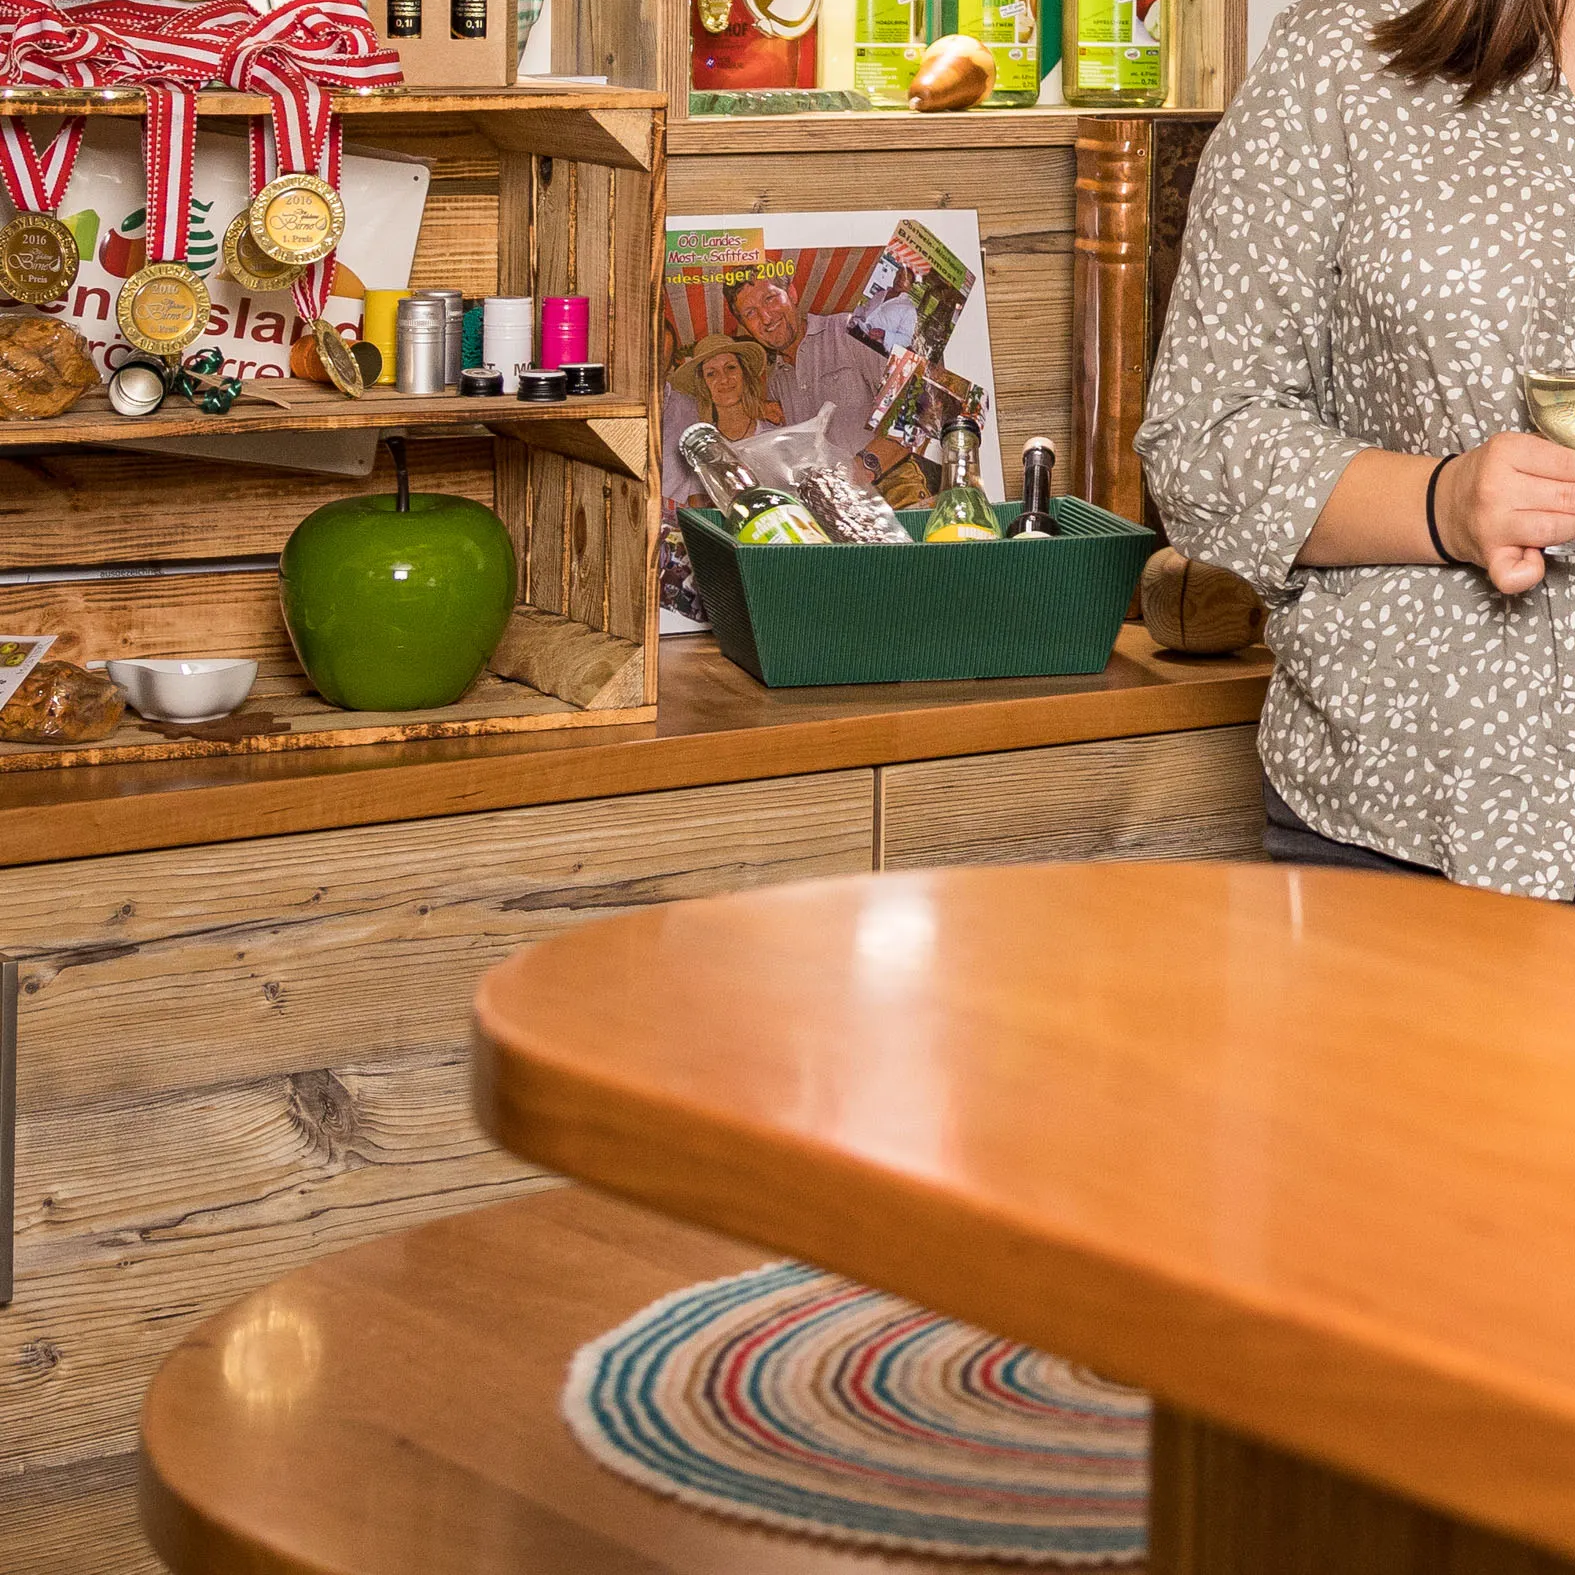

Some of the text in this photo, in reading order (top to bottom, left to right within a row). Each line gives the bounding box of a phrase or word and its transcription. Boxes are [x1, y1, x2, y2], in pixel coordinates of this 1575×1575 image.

[286, 195, 313, 206] 2016
[22, 234, 47, 245] 2016
[679, 232, 748, 247] OÖ Landes-
[669, 252, 703, 263] Most-
[710, 249, 760, 263] Saftfest
[757, 259, 795, 280] 2006
